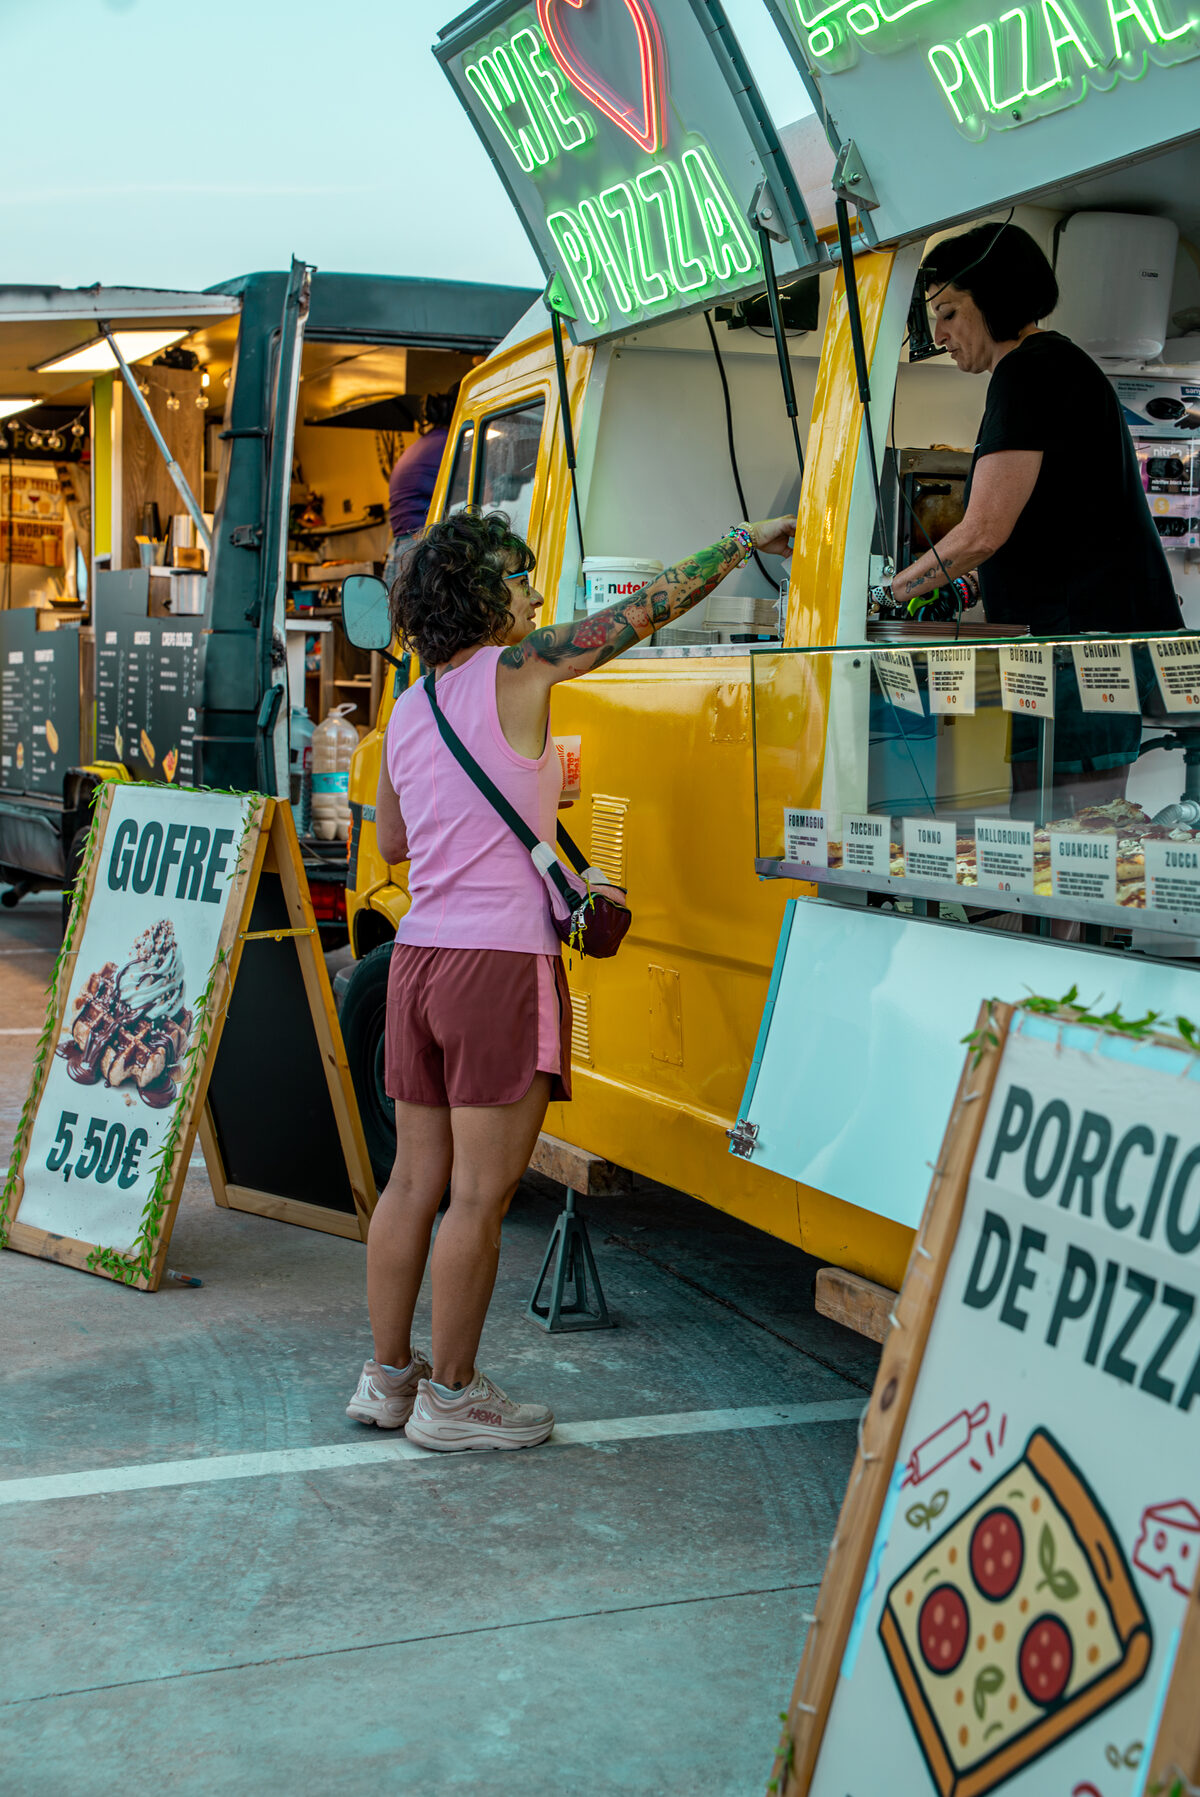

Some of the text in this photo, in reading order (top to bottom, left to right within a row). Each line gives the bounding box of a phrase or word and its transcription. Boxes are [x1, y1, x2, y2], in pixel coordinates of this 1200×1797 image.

[927, 0, 1099, 124] PIZZA
[465, 27, 588, 173] WE
[546, 148, 755, 325] PIZZA
[931, 648, 971, 662] PROSCIUTTO
[1009, 648, 1043, 665] BURRATA
[788, 814, 825, 830] FORMAGGIO
[850, 822, 883, 837] ZUCCHINI
[917, 829, 942, 845] TONNO
[977, 827, 1032, 846] MALLORQUINA
[1058, 841, 1110, 860] GUANCIALE
[1165, 851, 1199, 869] ZUCCA
[107, 818, 235, 904] GOFRE
[45, 1110, 149, 1190] 5,50€
[985, 1083, 1200, 1258] PORCIO
[962, 1209, 1200, 1413] DE PIZZ
[467, 1407, 503, 1426] HOKA
